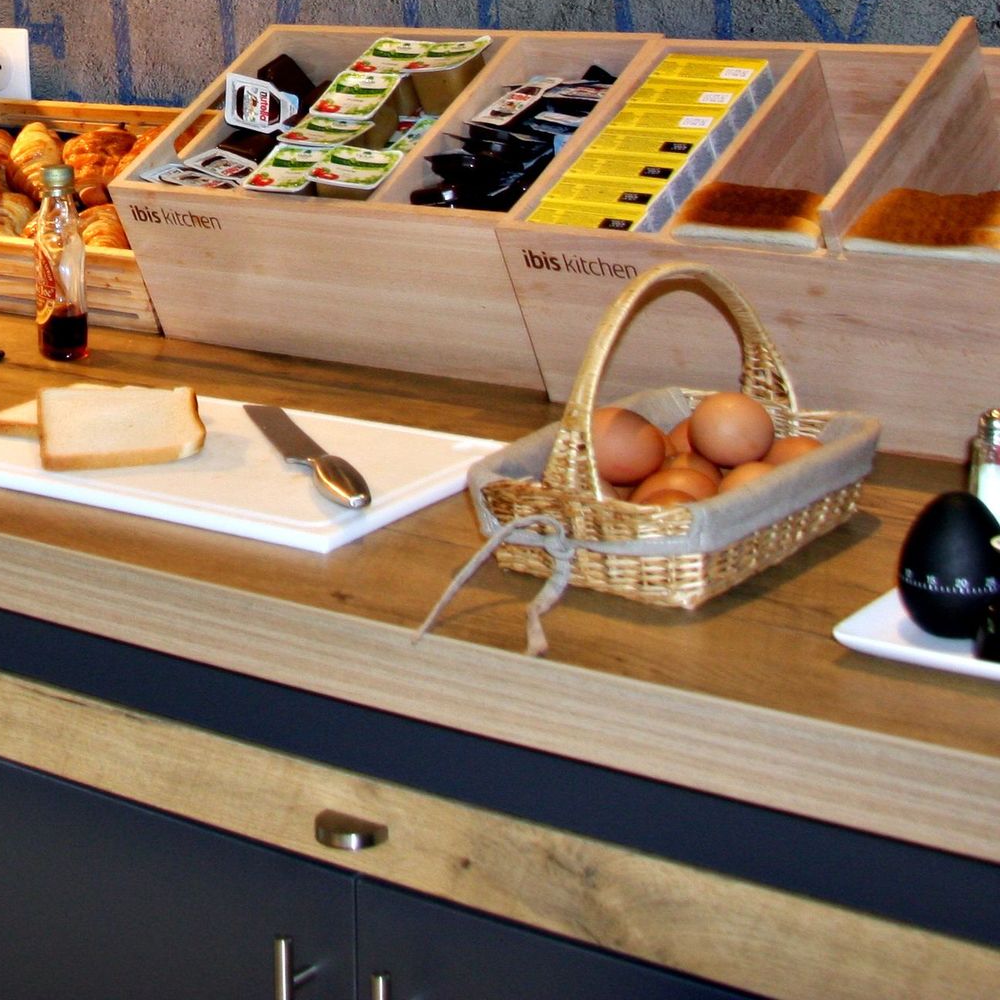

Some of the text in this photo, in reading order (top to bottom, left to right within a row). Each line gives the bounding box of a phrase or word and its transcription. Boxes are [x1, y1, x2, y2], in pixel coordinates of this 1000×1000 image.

[129, 204, 223, 231] ibis kitchen
[521, 248, 639, 280] ibis kitchen
